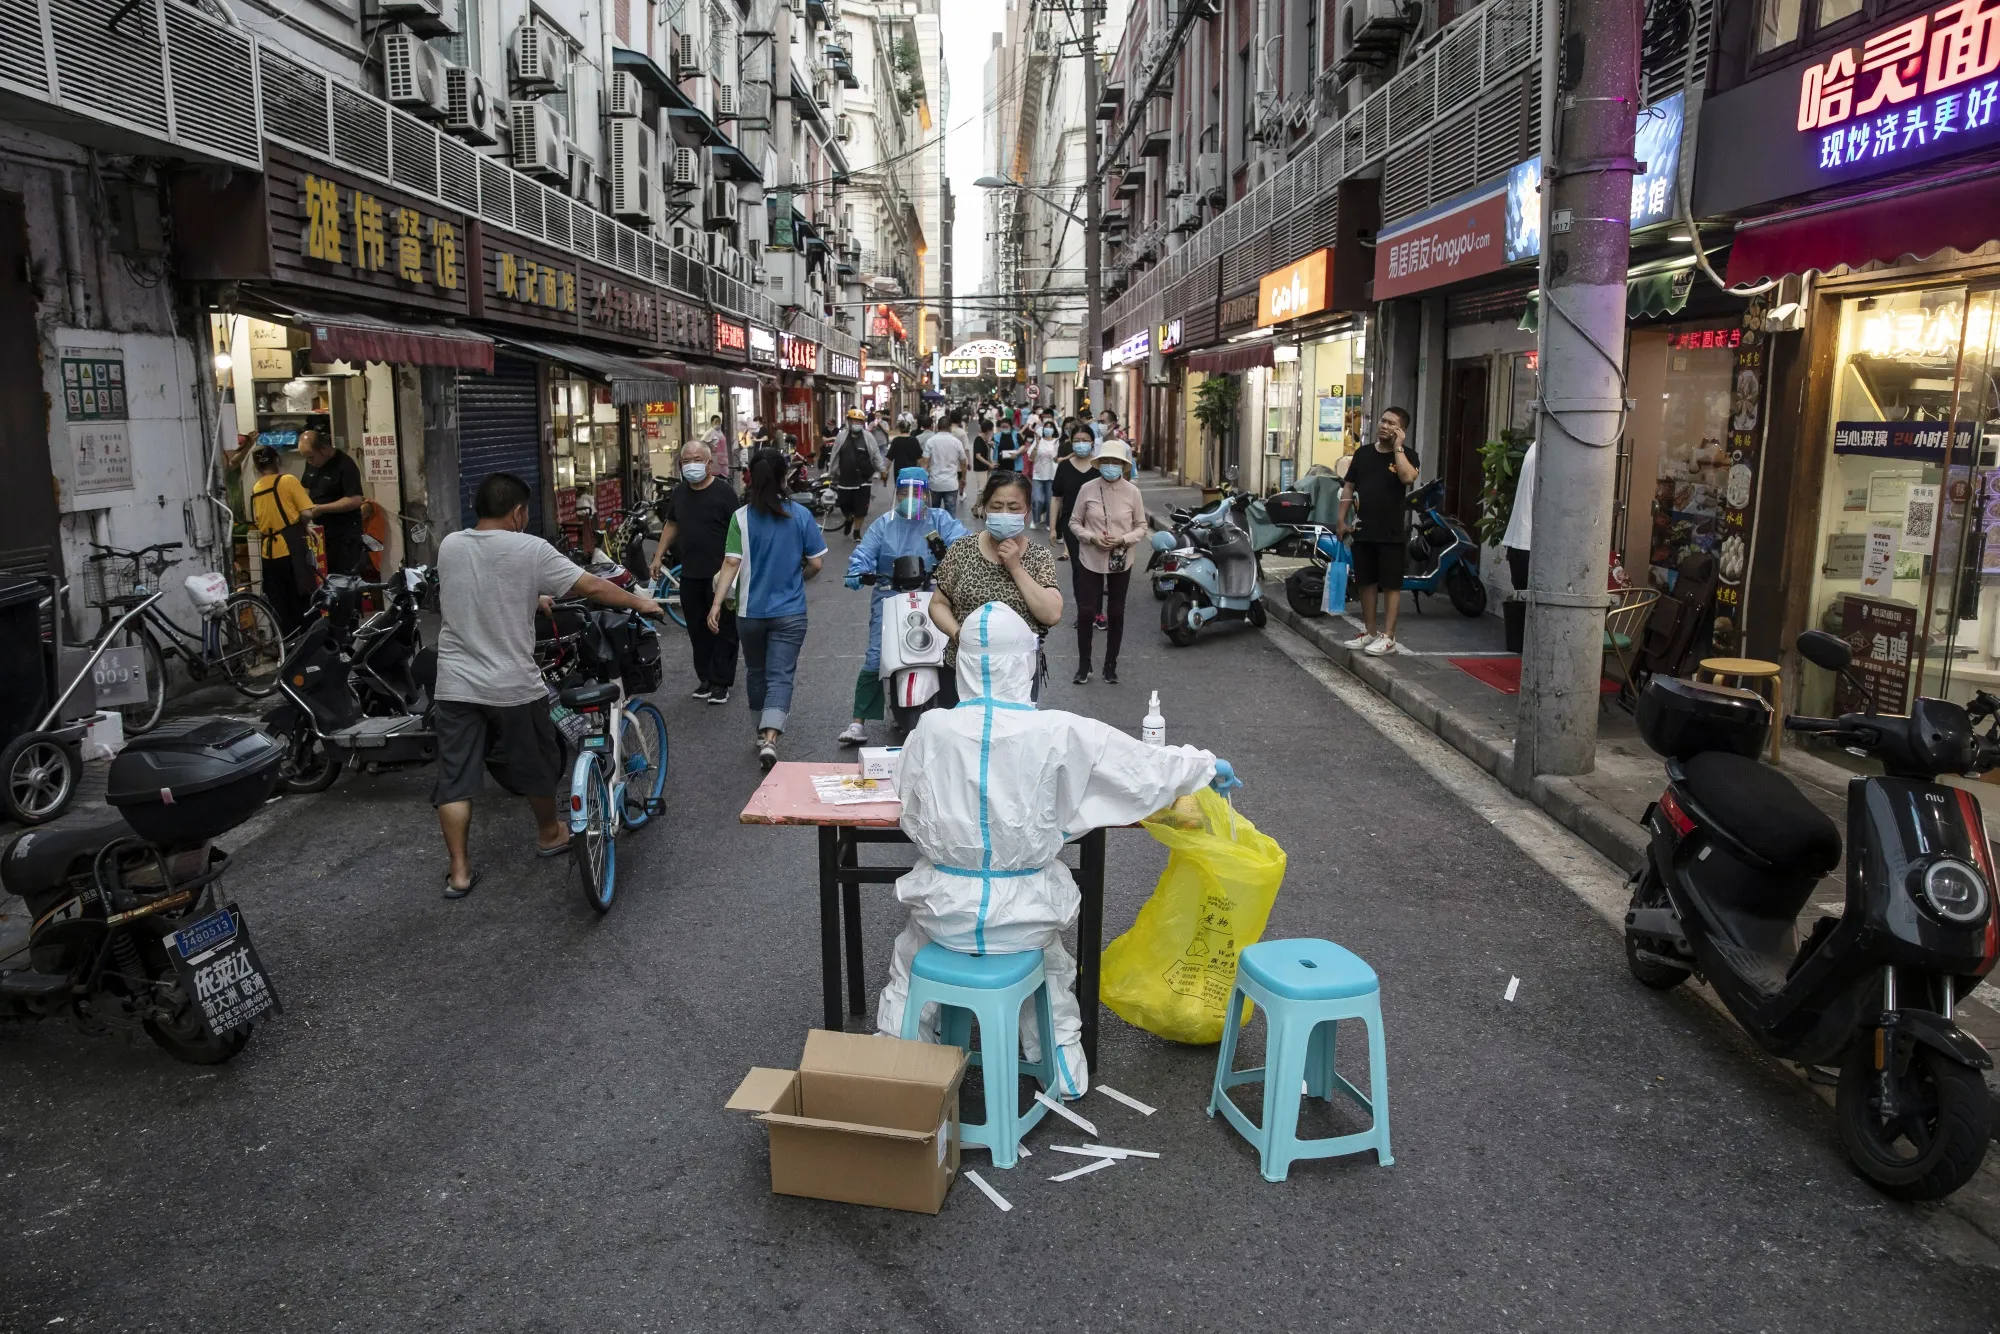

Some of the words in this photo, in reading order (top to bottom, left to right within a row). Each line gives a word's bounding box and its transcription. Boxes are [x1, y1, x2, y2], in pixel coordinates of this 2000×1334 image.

[1820, 80, 1998, 168] 现炒浇头更好
[303, 174, 457, 290] 雄伟餐馆
[1388, 237, 1431, 279] 易居房友
[1835, 430, 1889, 447] 当心玻璃
[1870, 632, 1909, 668] 急聘
[94, 668, 128, 685] 009
[182, 920, 229, 949] 7480513
